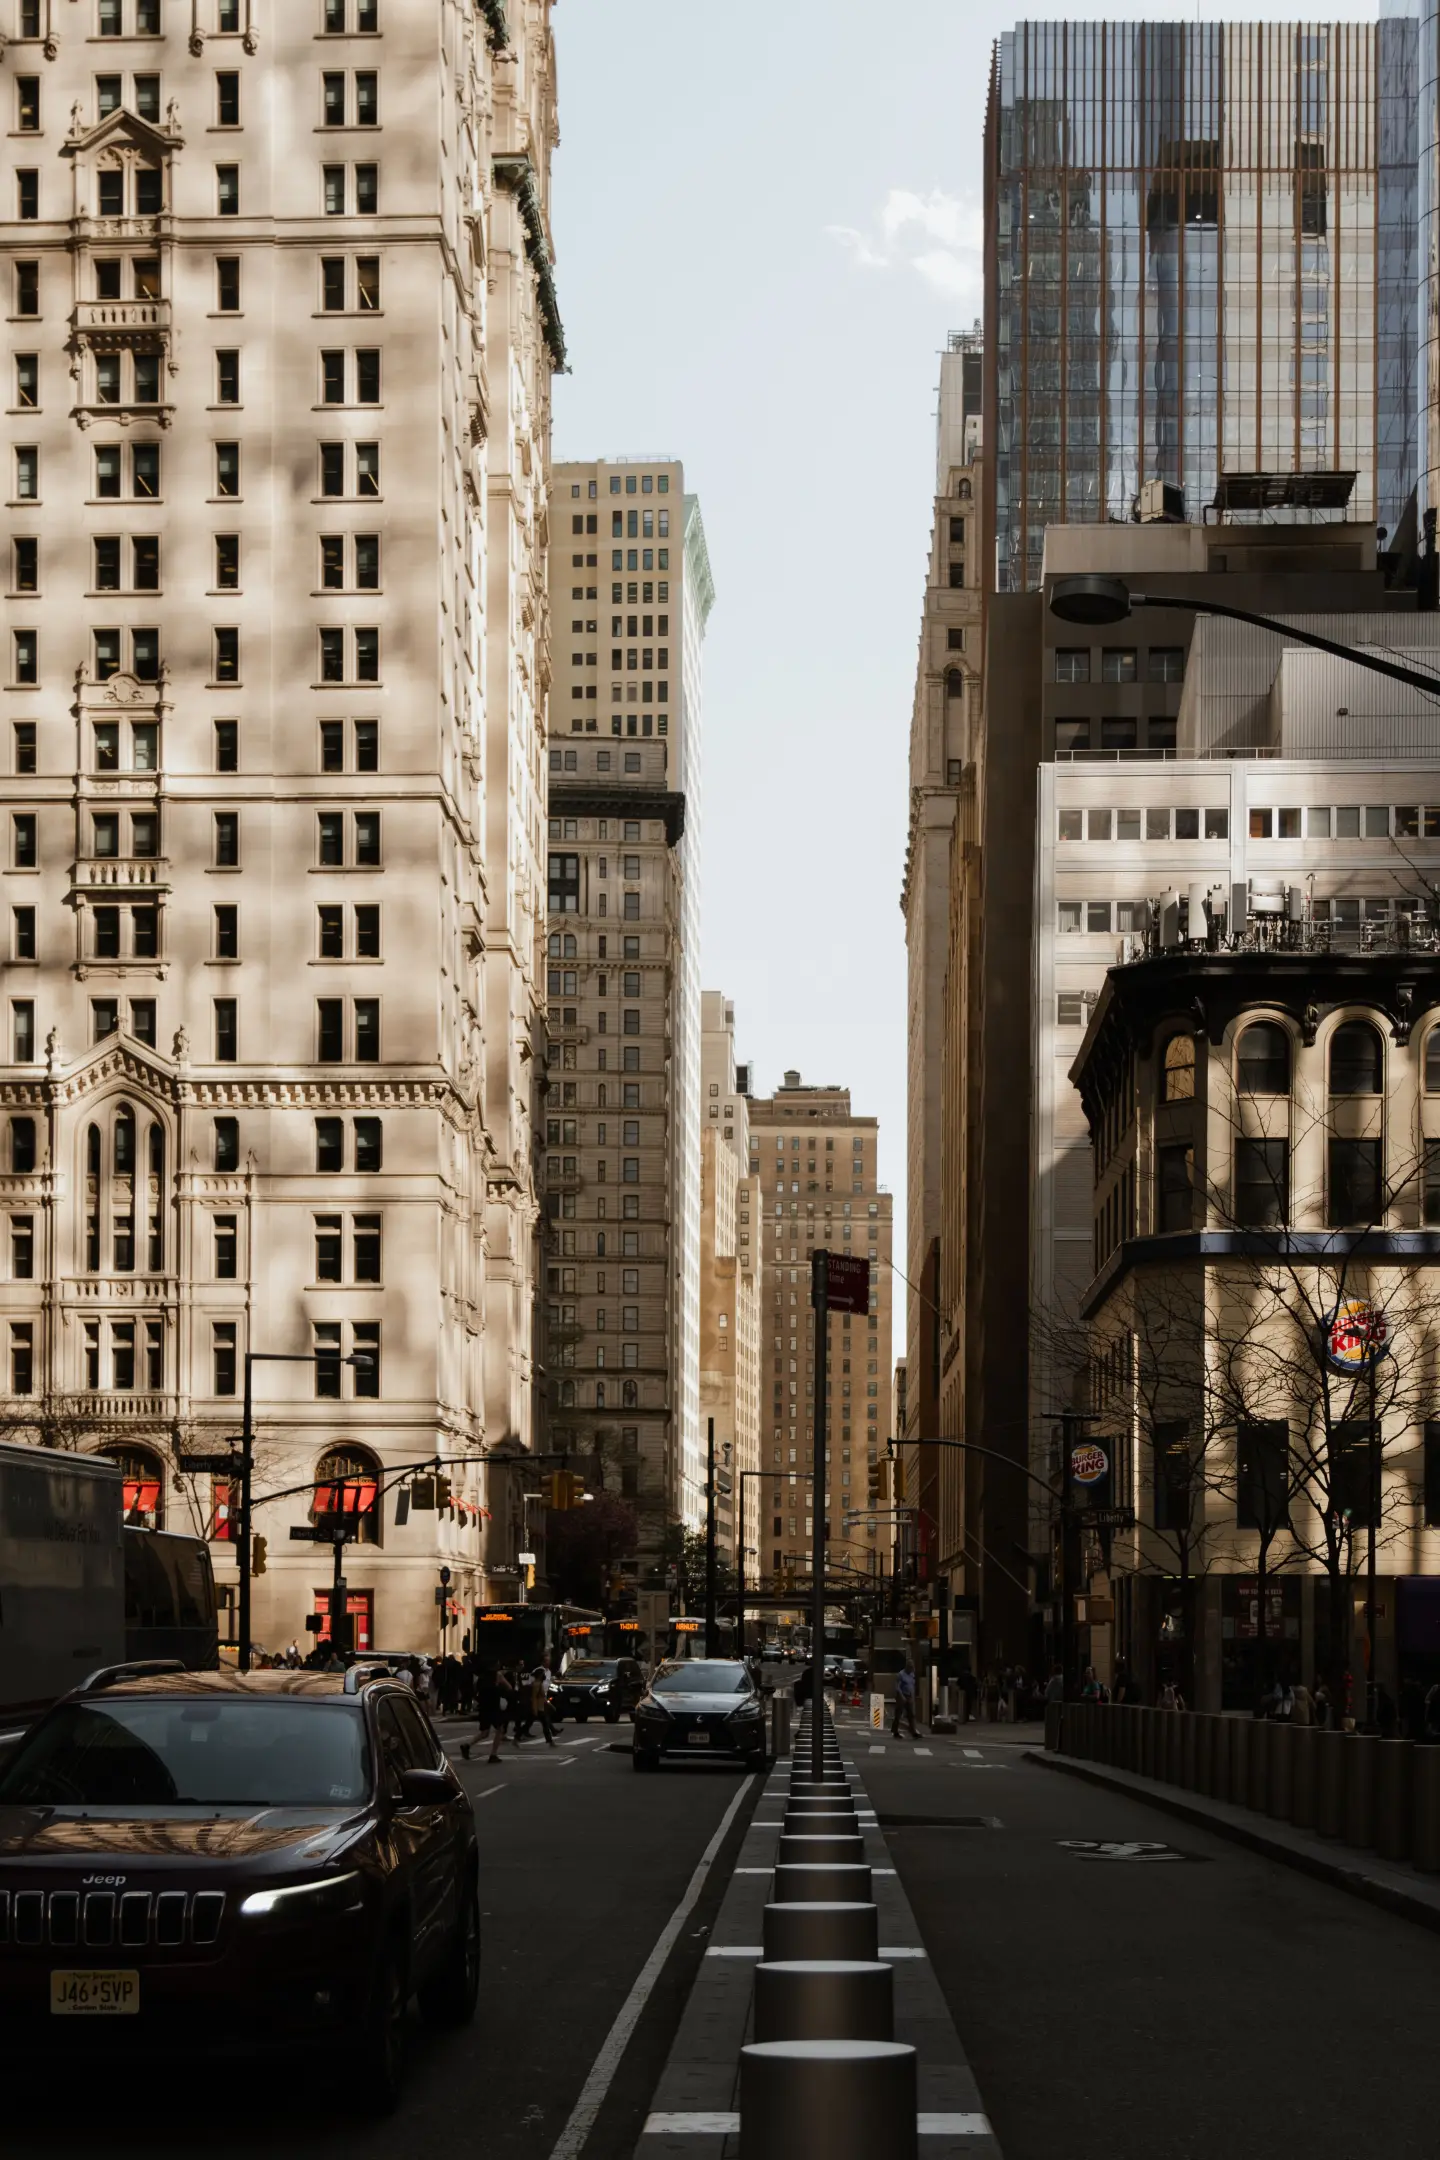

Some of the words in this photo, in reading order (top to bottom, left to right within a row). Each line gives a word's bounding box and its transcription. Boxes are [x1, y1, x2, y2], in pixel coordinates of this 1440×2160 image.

[828, 1259, 861, 1274] STANDING
[829, 1271, 845, 1284] time
[1098, 1511, 1124, 1524] Liberty
[82, 1873, 127, 1887] Jeep
